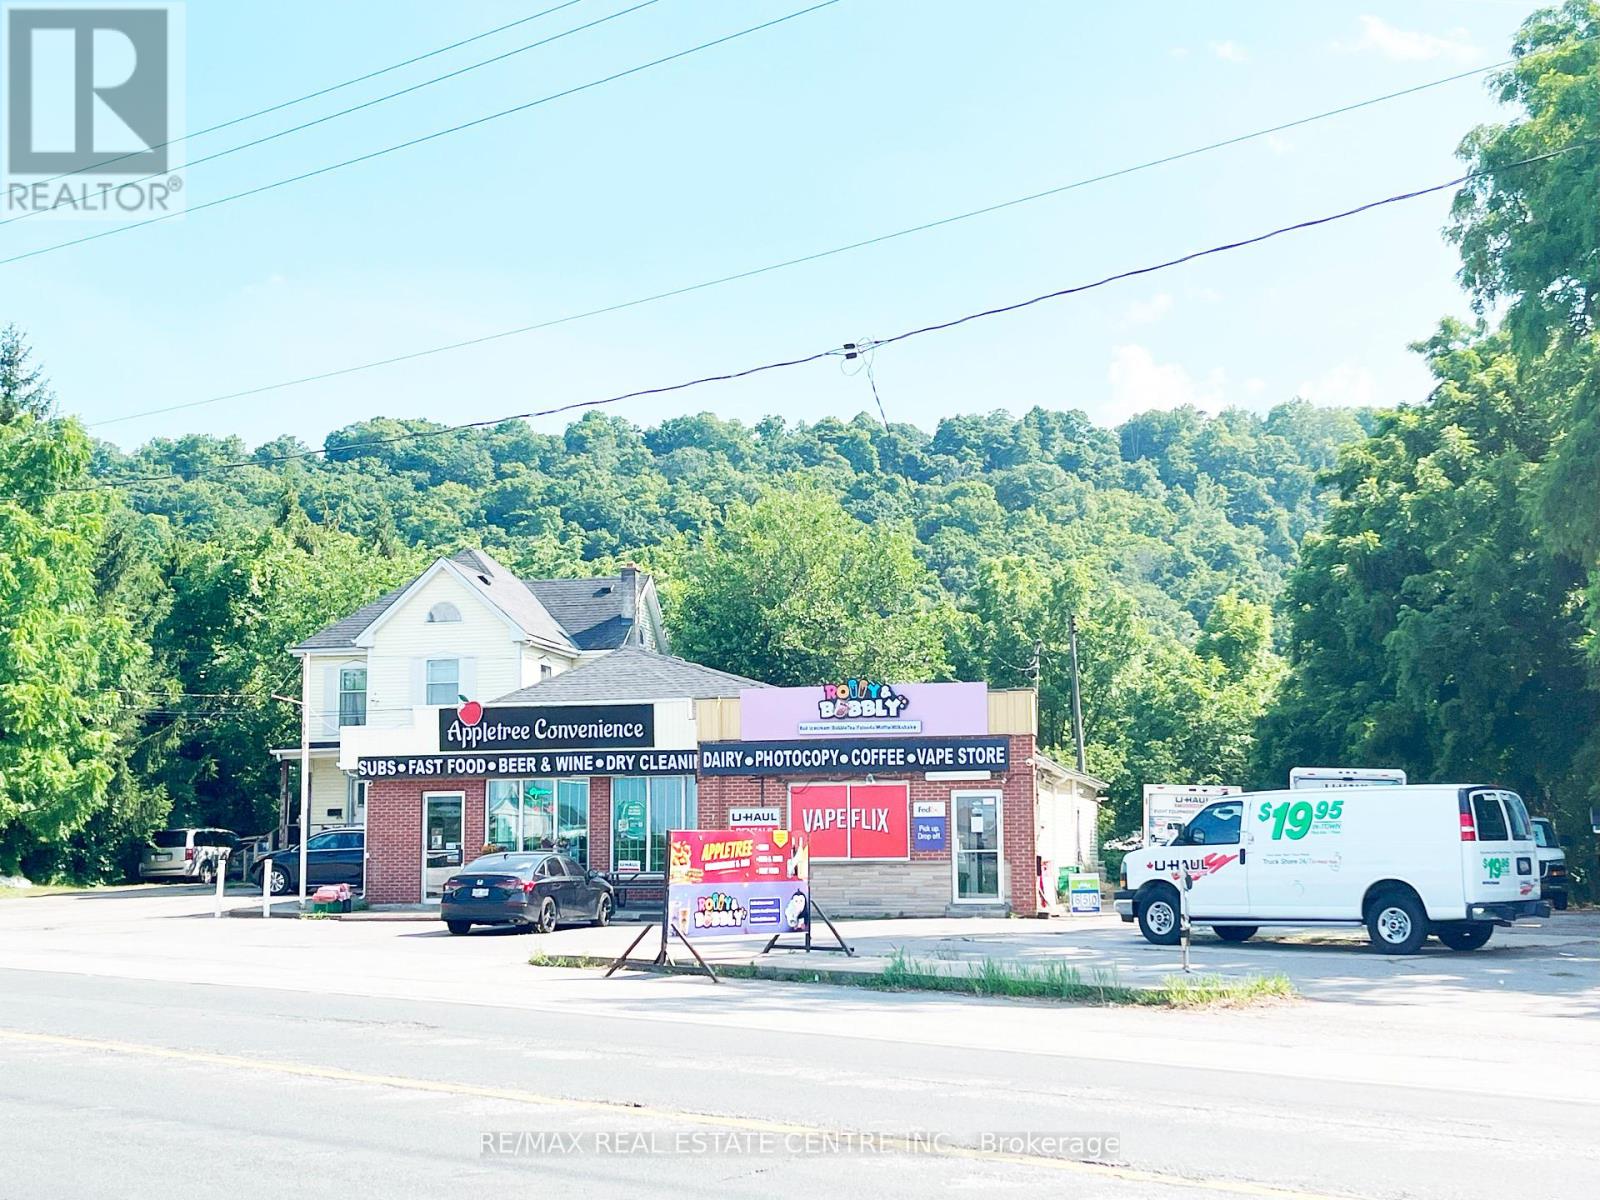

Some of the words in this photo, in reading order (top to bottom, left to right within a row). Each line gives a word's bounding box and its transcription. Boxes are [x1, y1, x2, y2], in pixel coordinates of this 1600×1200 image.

[447, 720, 531, 748] Appletree
[534, 718, 644, 740] Convenience
[358, 759, 397, 776] SUBS
[408, 758, 444, 775] FAST
[447, 758, 487, 774] FOOD
[498, 757, 537, 773] BEER
[540, 756, 552, 772] &
[556, 755, 594, 772] WINE
[606, 754, 636, 771] DRY
[703, 750, 744, 768] DAIRY
[755, 749, 840, 768] PHOTOCOPY
[851, 748, 905, 766] COFFEE
[916, 747, 954, 765] VAPE
[957, 746, 1006, 764] STORE
[731, 812, 778, 822] U-HAUL
[701, 839, 753, 861] APPLETREE
